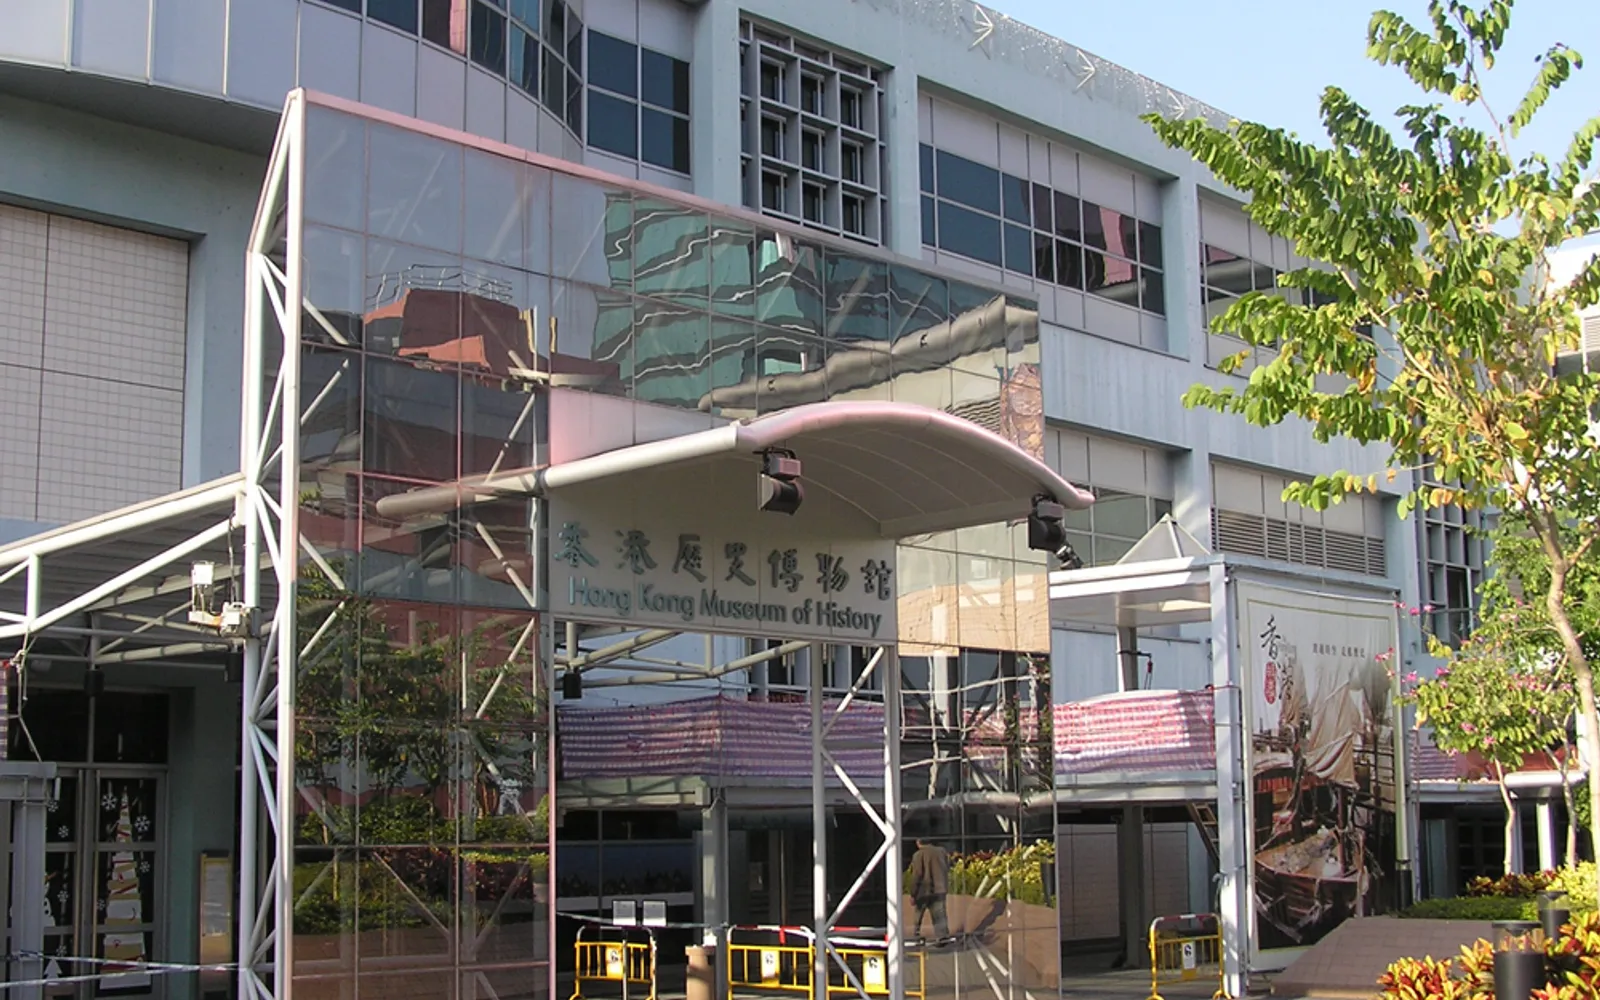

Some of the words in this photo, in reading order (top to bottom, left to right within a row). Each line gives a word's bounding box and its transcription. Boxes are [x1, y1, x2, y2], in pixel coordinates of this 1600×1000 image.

[568, 575, 631, 617] Hong
[637, 582, 695, 622] Kong
[700, 588, 787, 622] Museum
[792, 598, 813, 625] of
[816, 600, 882, 638] History
